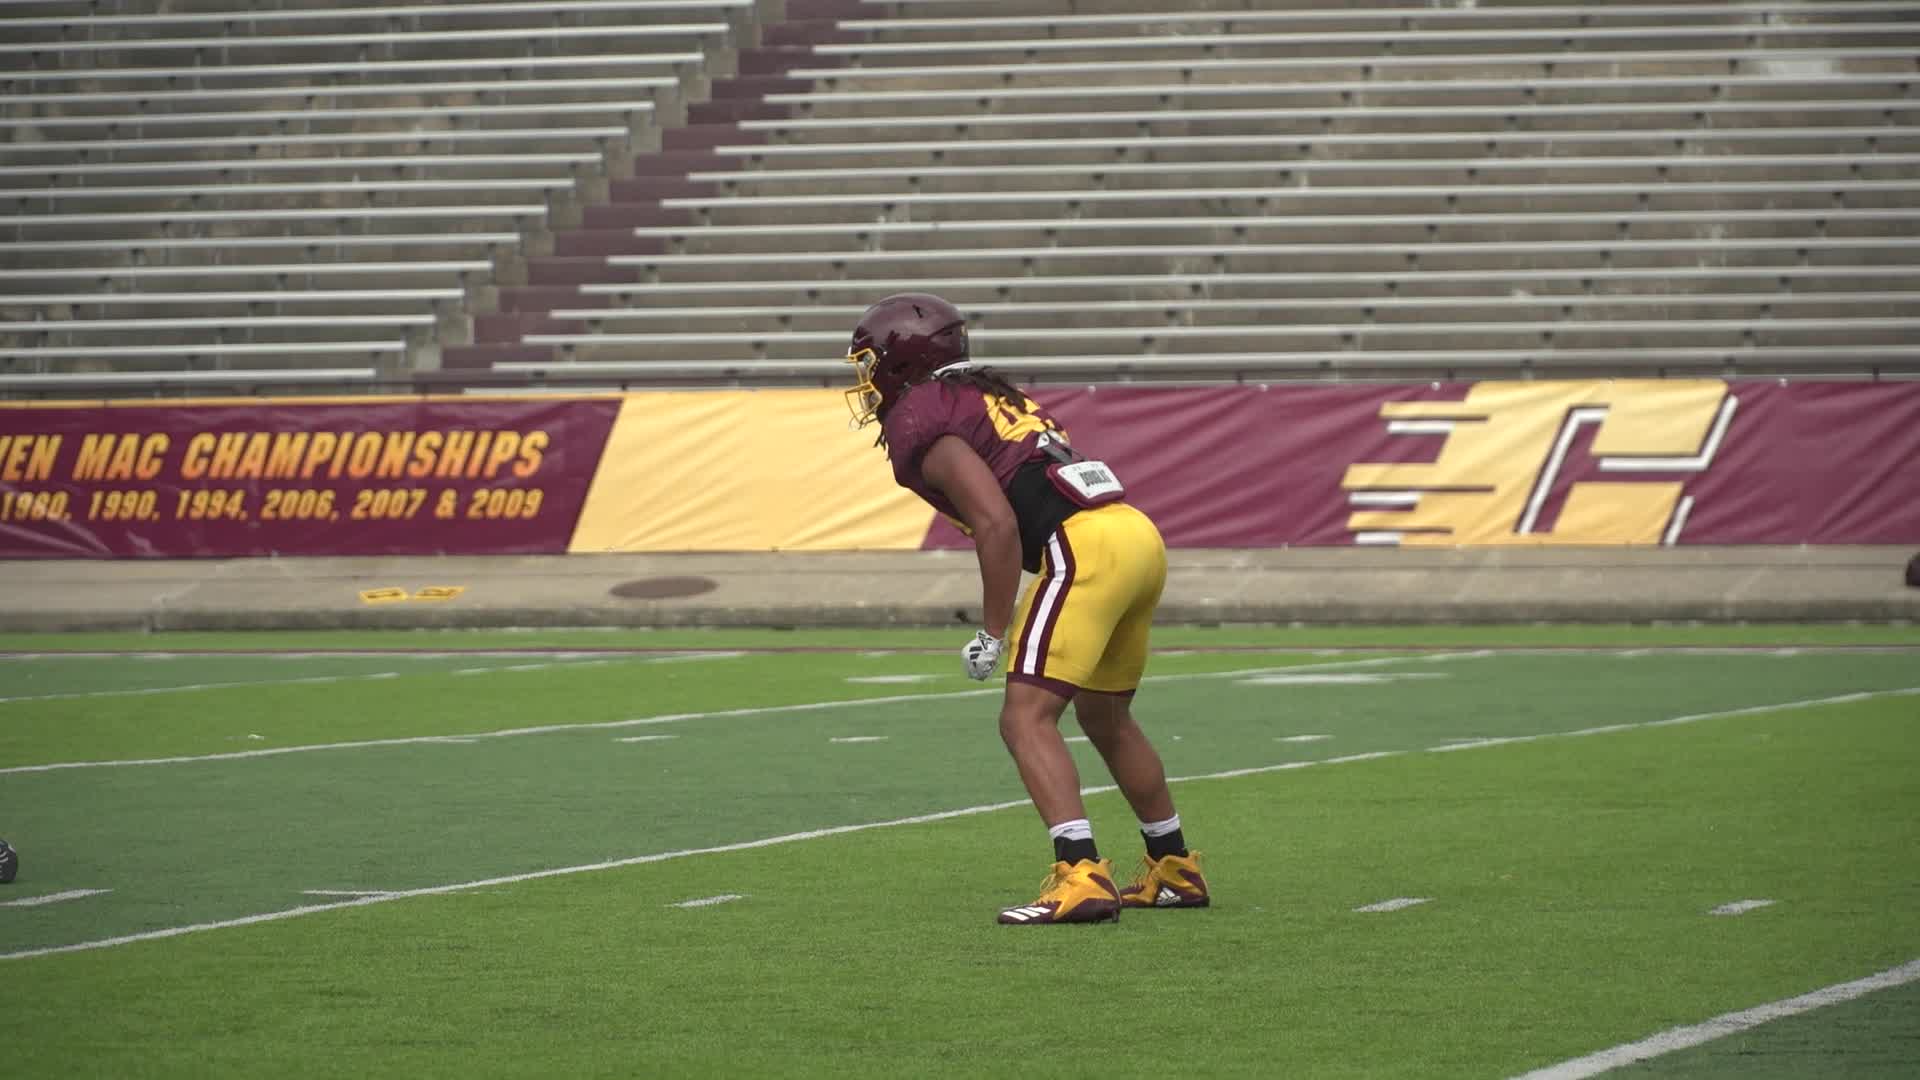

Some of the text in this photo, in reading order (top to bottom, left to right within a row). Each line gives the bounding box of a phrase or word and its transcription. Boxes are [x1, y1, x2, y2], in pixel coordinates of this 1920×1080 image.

[71, 433, 170, 480] MAC
[180, 430, 549, 479] CHAMPIONSHIPS
[351, 488, 427, 519] 2007
[434, 488, 457, 518] &
[467, 488, 544, 518] 2009
